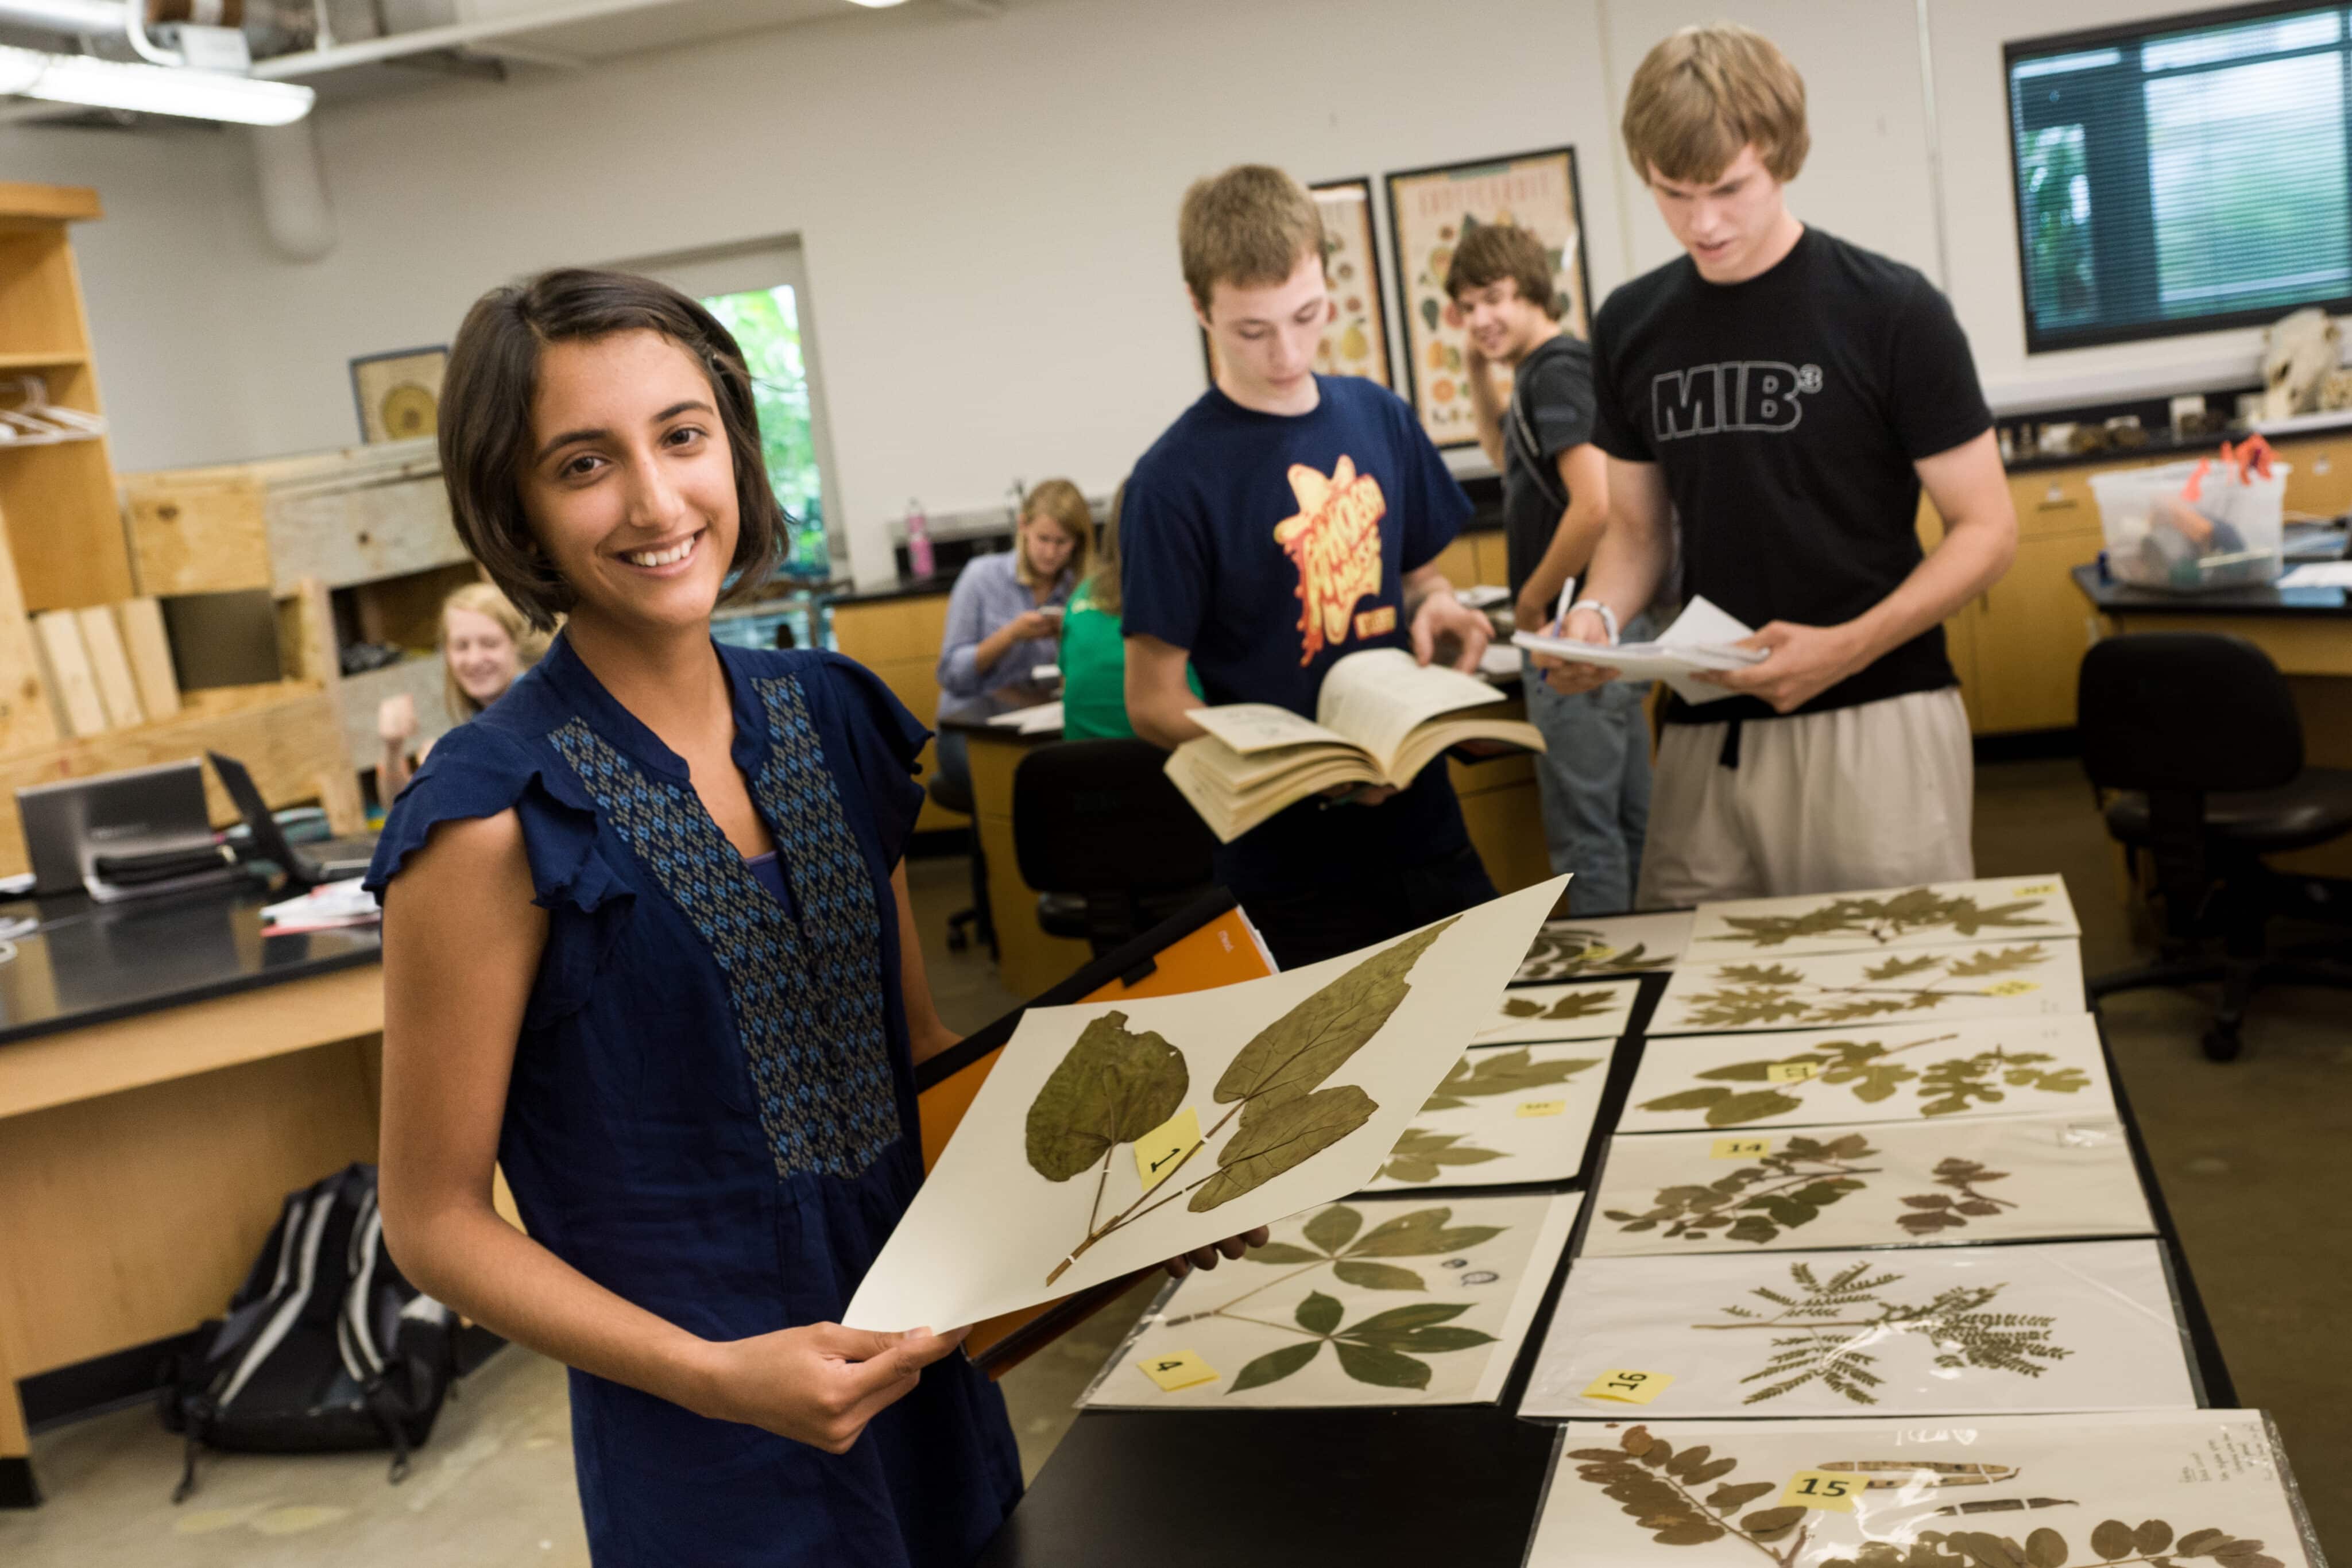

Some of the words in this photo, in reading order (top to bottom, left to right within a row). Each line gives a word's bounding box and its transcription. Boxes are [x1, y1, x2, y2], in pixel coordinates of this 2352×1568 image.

[1150, 1148, 1181, 1174] 1
[1156, 1361, 1184, 1372] 4
[1608, 1372, 1648, 1391] 16
[1796, 1478, 1850, 1497] 15
